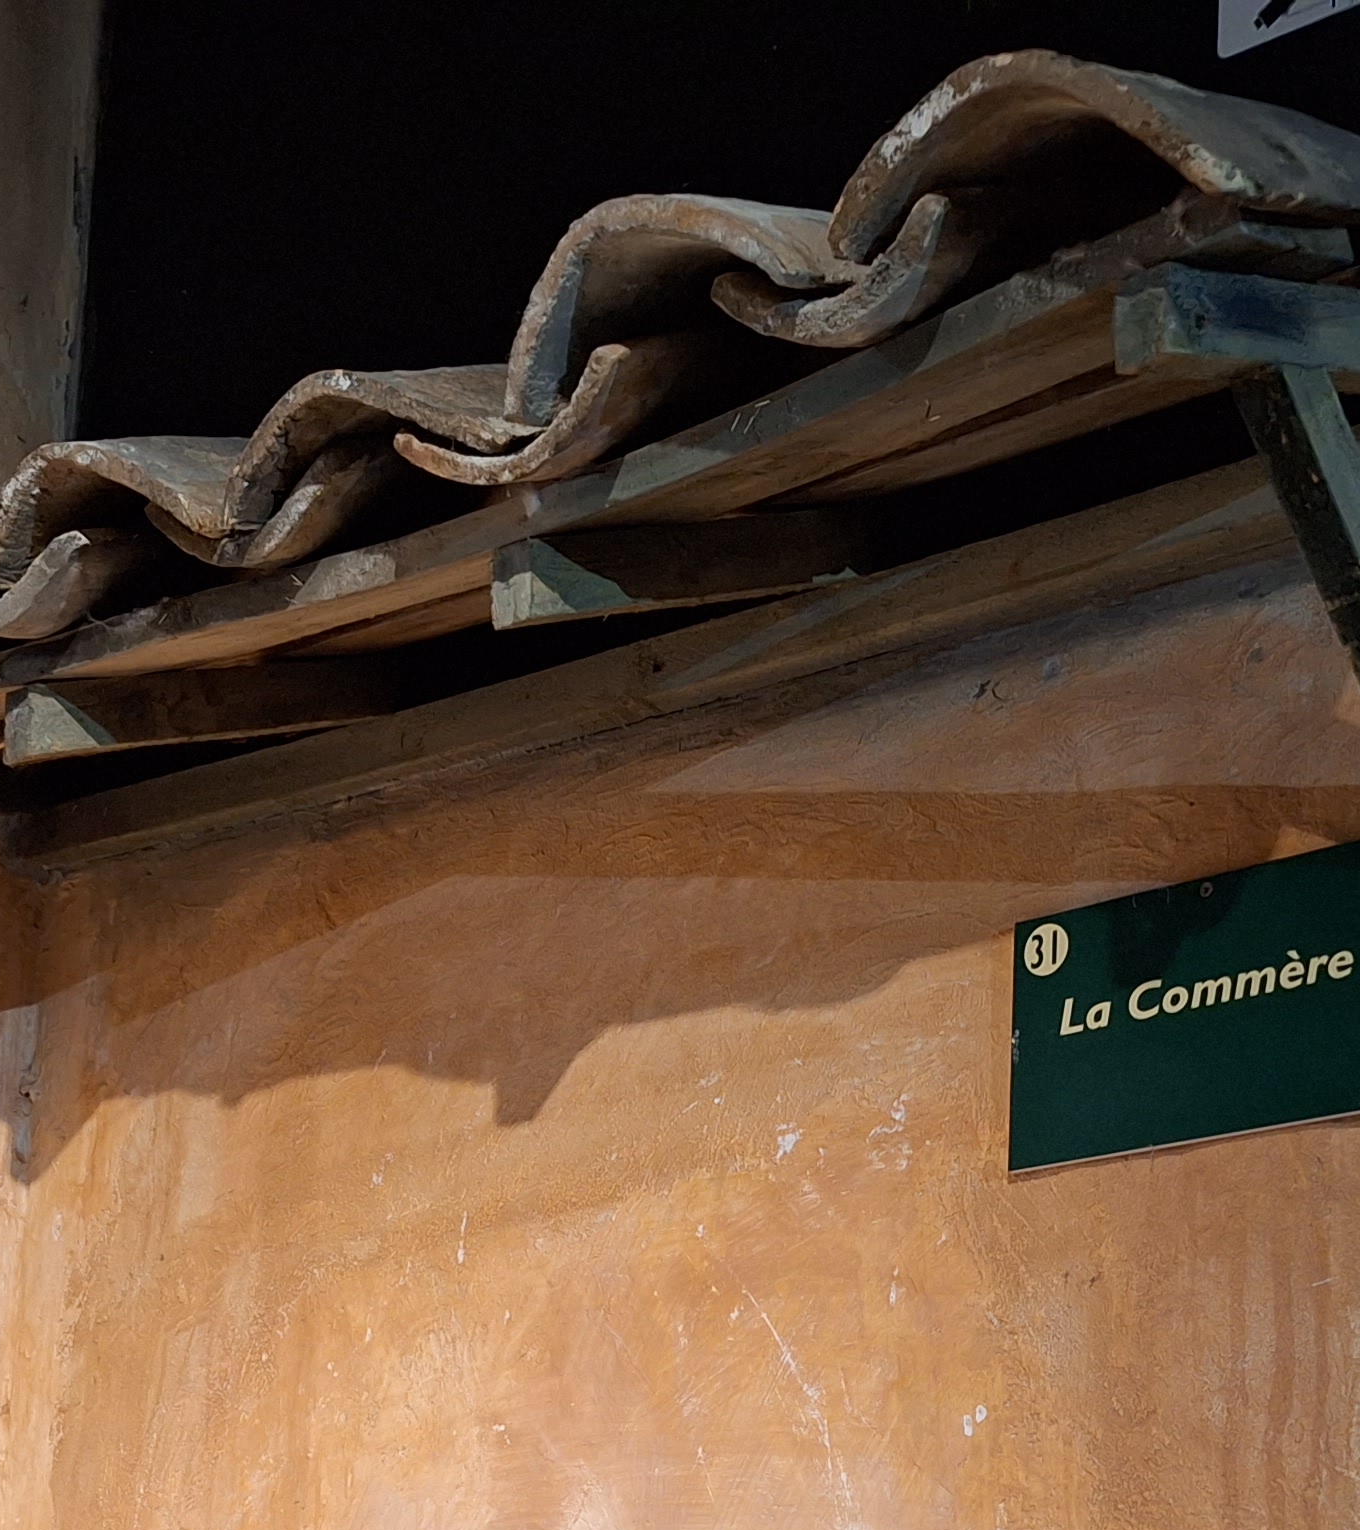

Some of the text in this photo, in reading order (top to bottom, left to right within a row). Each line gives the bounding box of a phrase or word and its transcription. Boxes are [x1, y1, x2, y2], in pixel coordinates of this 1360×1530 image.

[1030, 929, 1058, 970] 31
[1059, 949, 1355, 1036] La Commère
